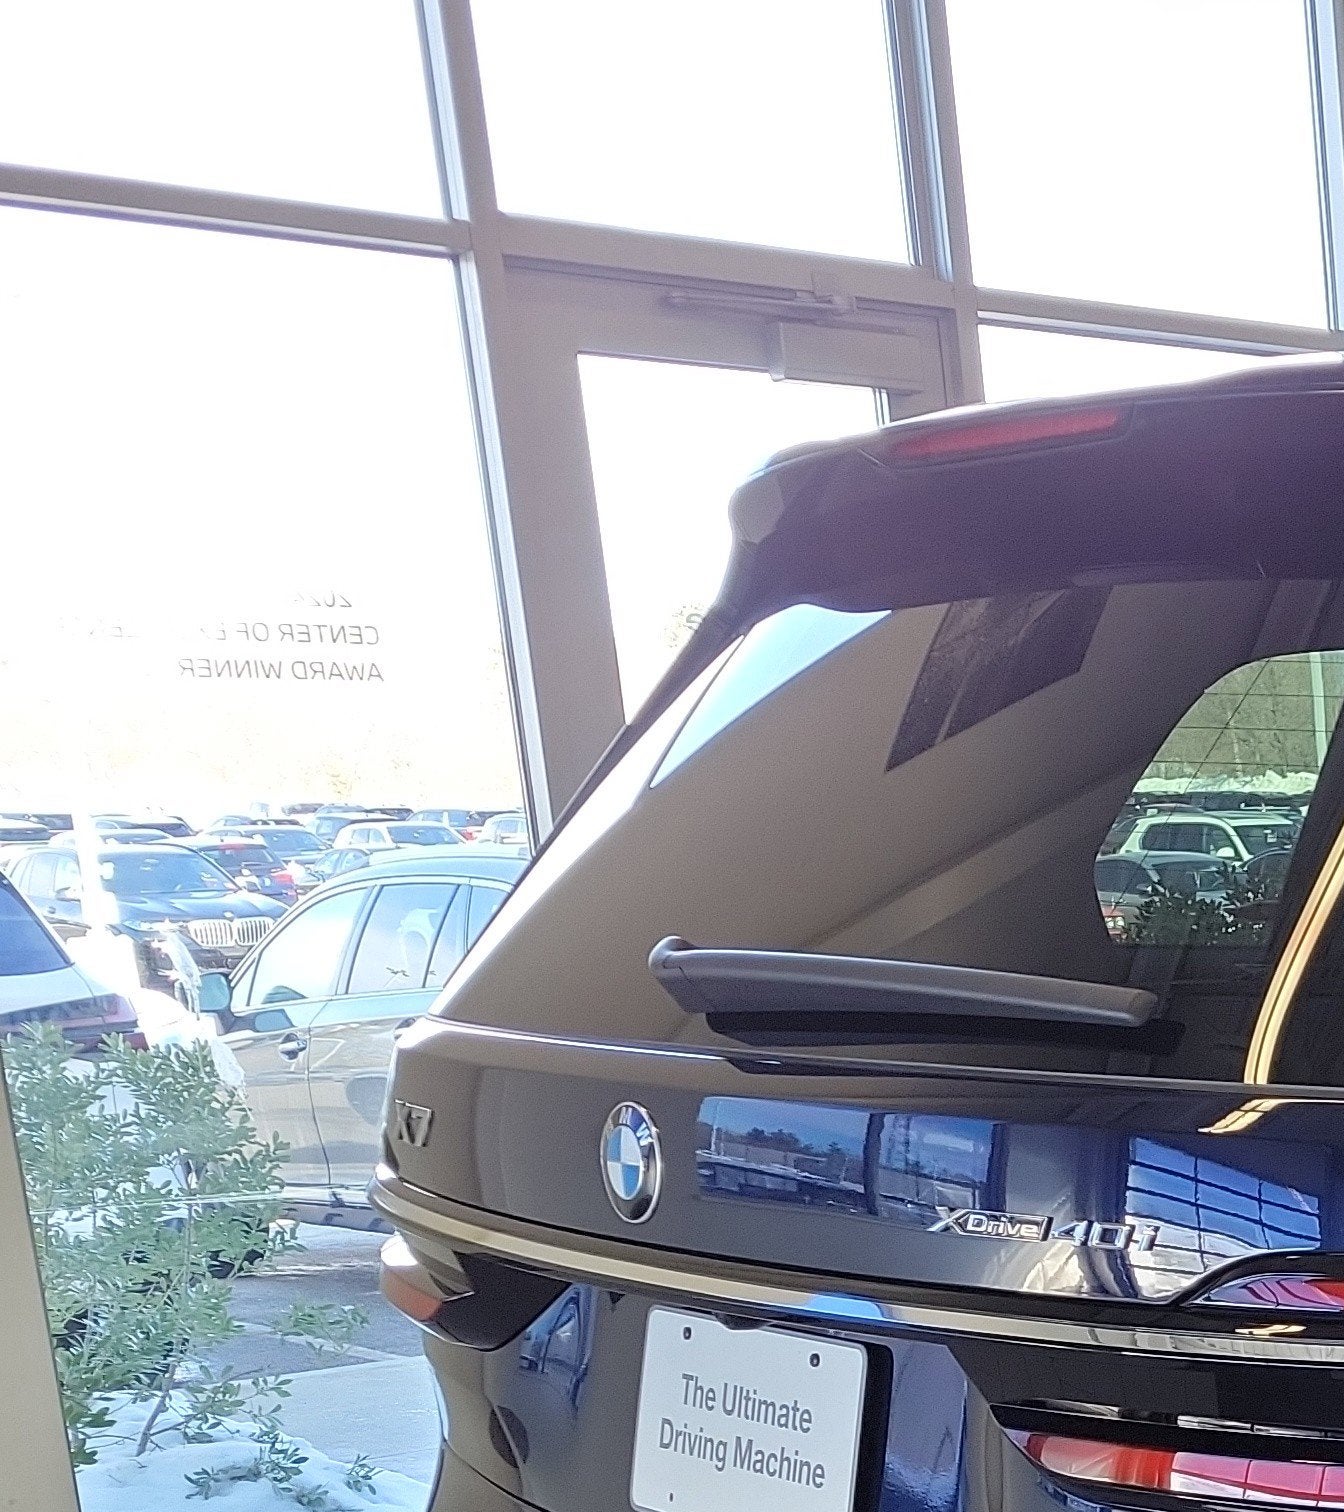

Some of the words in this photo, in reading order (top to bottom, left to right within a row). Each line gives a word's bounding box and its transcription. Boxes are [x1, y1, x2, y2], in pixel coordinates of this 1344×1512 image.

[394, 1099, 432, 1147] X7
[681, 1372, 717, 1412] The
[721, 1382, 813, 1434] Ultimate
[658, 1417, 728, 1472] Driving
[732, 1436, 826, 1489] Machine
